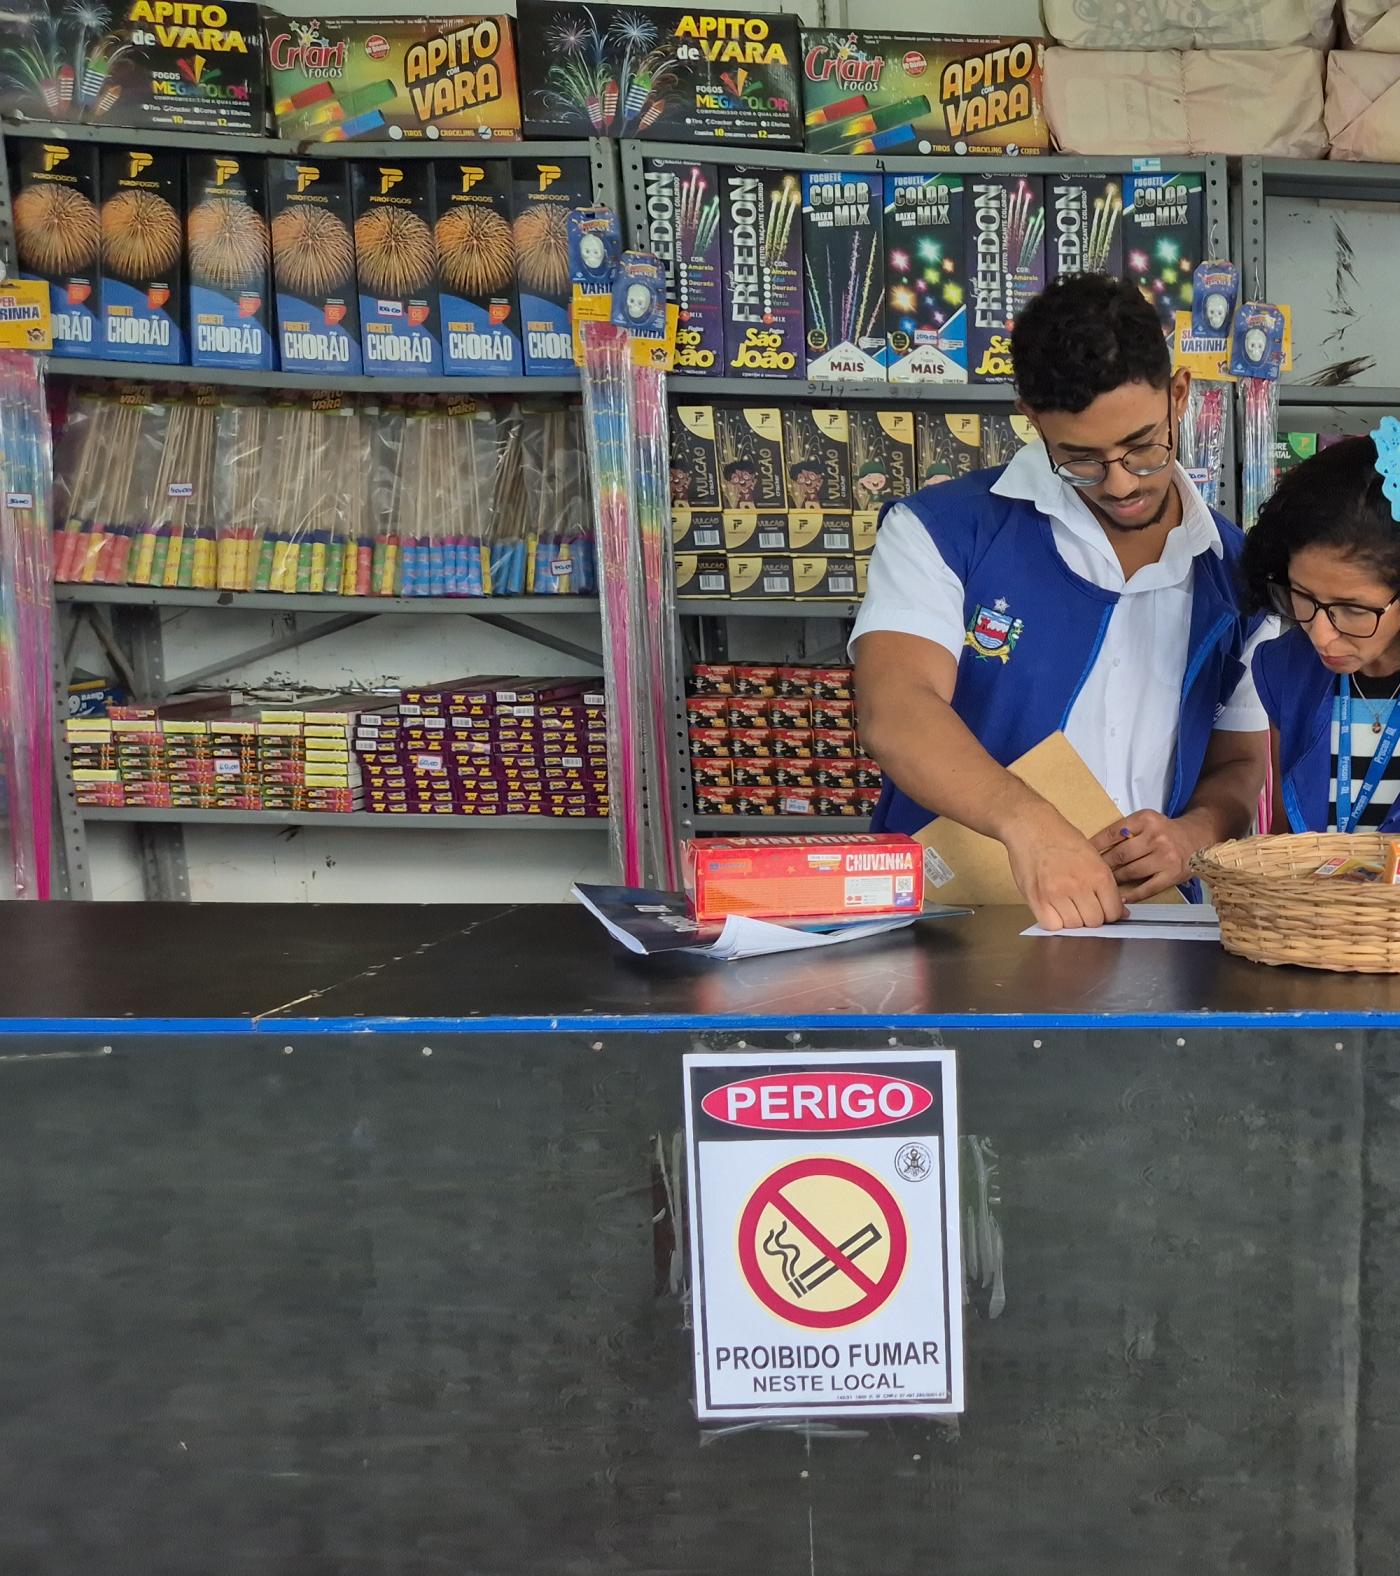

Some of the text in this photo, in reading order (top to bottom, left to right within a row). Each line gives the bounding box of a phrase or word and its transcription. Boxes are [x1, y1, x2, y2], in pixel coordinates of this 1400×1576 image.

[129, 0, 228, 27] APITO
[132, 26, 248, 53] de VARA
[674, 15, 769, 40] APITO
[407, 21, 498, 83] APITO
[677, 40, 788, 65] de VARA
[152, 71, 180, 80] FOGOS
[309, 68, 342, 78] FOGOS
[943, 42, 1032, 100] APITO
[413, 64, 499, 121] VARA
[843, 81, 879, 91] FOGOS
[946, 83, 1029, 137] VARA
[810, 183, 870, 205] COLOR
[894, 185, 949, 206] COLOR
[1134, 185, 1187, 207] COLOR
[834, 204, 870, 225] MIX
[917, 205, 950, 225] MIX
[1156, 205, 1187, 226] MIX
[973, 185, 1005, 328] FREEDON
[0, 305, 39, 321] RINHA
[108, 315, 169, 346] CHORÃO
[198, 324, 262, 355] CHORÃO
[745, 327, 782, 347] São
[285, 332, 349, 362] CHORÃO
[368, 332, 432, 363] CHORÃO
[449, 331, 512, 360] CHORÃO
[528, 332, 573, 360] CHOR
[730, 343, 796, 370] João
[830, 361, 864, 373] MAIS
[911, 363, 945, 375] MAIS
[727, 834, 876, 847] CHUVINHA
[845, 852, 913, 872] CHUVINHA
[726, 1082, 914, 1122] PERIGO
[716, 1341, 940, 1371] PROIBIDO FUMAR
[753, 1373, 905, 1392] NESTE LOCAL
